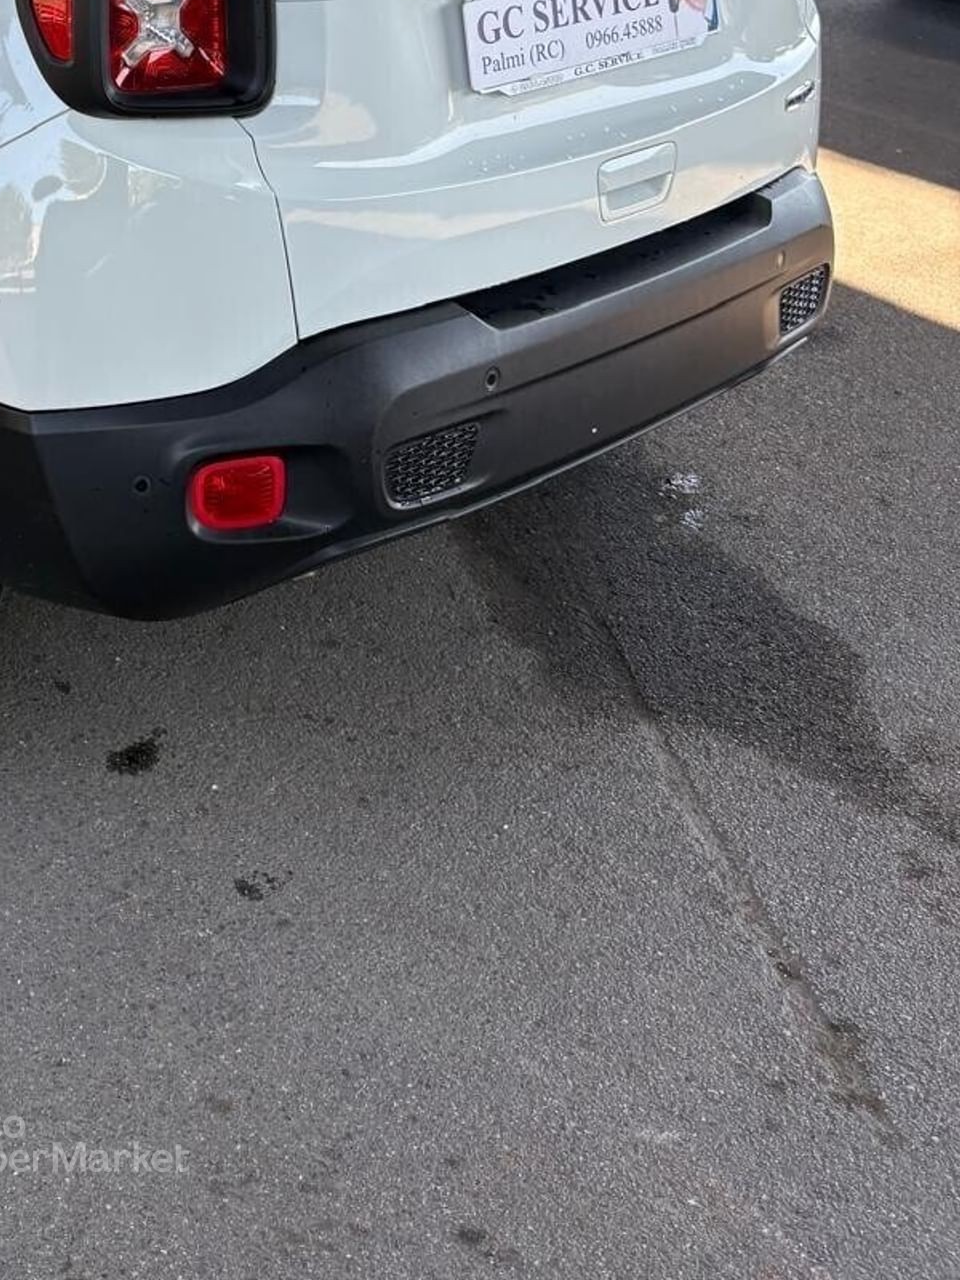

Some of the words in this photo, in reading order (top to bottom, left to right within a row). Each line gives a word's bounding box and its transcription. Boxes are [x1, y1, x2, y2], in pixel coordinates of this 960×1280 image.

[477, 6, 525, 45] GC
[481, 48, 526, 75] Palmi
[529, 40, 566, 65] (RC)
[585, 15, 664, 50] 0966.45888
